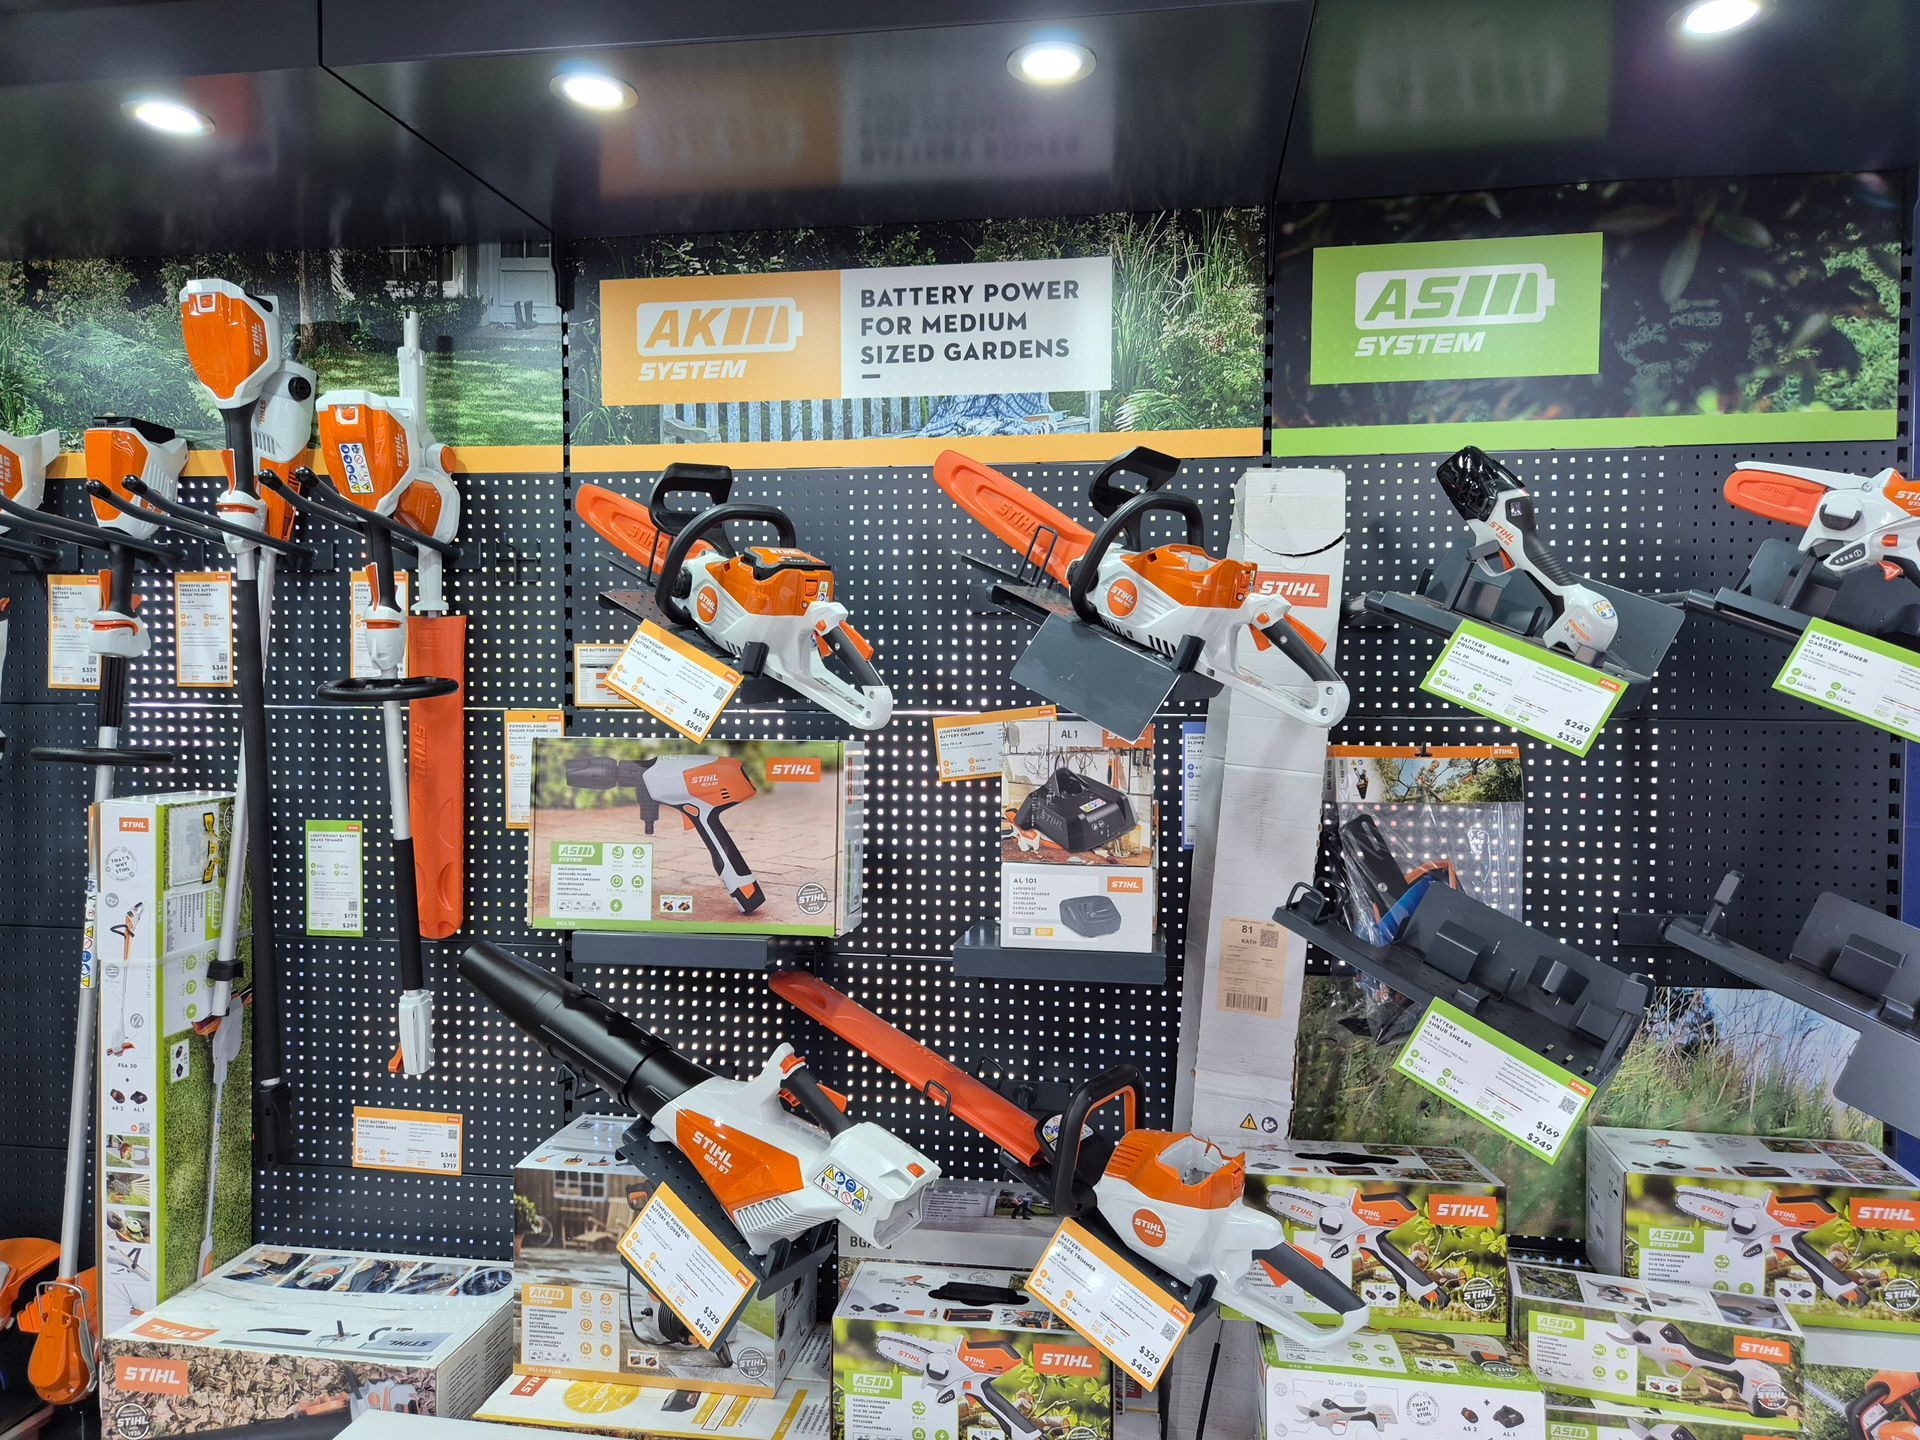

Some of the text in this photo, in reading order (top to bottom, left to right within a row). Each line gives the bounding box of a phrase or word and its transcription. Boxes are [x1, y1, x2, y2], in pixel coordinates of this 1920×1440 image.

[860, 280, 1079, 308] BATTERY POWER
[860, 311, 1027, 336] FOR MEDIUM
[251, 323, 260, 357] STIHL
[1355, 332, 1486, 357] SYSTEM
[861, 339, 1070, 364] SIZED GARDENS
[639, 359, 747, 381] SYSTEM
[394, 433, 404, 468] STIHL
[1489, 521, 1514, 544] STIHL
[1110, 586, 1134, 604] STIHL
[1259, 580, 1321, 598] STIHL
[699, 592, 715, 611] STIHL
[637, 633, 665, 651] LIGHTWEIGHT
[1460, 636, 1488, 650] BATTERY
[1811, 634, 1842, 648] BATTERY
[635, 639, 671, 662] BATTERY CHAINSAW
[1457, 641, 1510, 666] PRUNING SHEARS
[1808, 639, 1869, 664] GARDEN PRUNER
[693, 708, 710, 722] $399
[685, 719, 703, 733] $549
[1061, 729, 1078, 739] AL 1
[1564, 718, 1591, 734] $249
[1557, 731, 1583, 747] $329
[415, 723, 427, 782] STIHL
[771, 763, 815, 775] STIHL
[691, 774, 719, 785] STIHL
[1039, 811, 1064, 832] STIHL
[1112, 880, 1139, 889] STIHL
[799, 892, 827, 904] STIHL
[1242, 925, 1253, 934] 81
[1431, 1015, 1457, 1032] BATTERY
[1429, 1021, 1473, 1048] SHRUB SHEARS
[1536, 1121, 1560, 1138] $169
[692, 1130, 733, 1168] STIHL
[1527, 1133, 1553, 1151] $249
[704, 1153, 718, 1167] BGA
[1289, 1204, 1314, 1218] STIHL
[1357, 1208, 1381, 1218] STIHL
[1436, 1204, 1489, 1218] STIHL
[1699, 1204, 1726, 1218] STIHL
[1772, 1209, 1798, 1219] STIHL
[1857, 1207, 1916, 1222] STIHL
[651, 1205, 667, 1221] BATTERY
[665, 1220, 681, 1238] BLOWER
[654, 1200, 672, 1218] COMPACT
[670, 1215, 690, 1240] POWERFUL
[1135, 1218, 1164, 1234] STIHL
[1060, 1235, 1082, 1252] BATTERY
[1057, 1240, 1097, 1272] HEDGE TRIMMER
[1464, 1289, 1496, 1300] STIHL
[1885, 1290, 1919, 1300] STIHL
[704, 1306, 720, 1325] $329
[1173, 1308, 1188, 1320] STIHL
[151, 1324, 207, 1338] STIHL
[695, 1319, 712, 1337] $429
[898, 1350, 920, 1363] STIHL
[1139, 1345, 1160, 1365] $329
[1661, 1346, 1683, 1354] STIHL
[1740, 1341, 1784, 1357] STIHL
[737, 1357, 767, 1368] STIHL
[963, 1355, 986, 1365] STIHL
[1040, 1353, 1093, 1368] STIHL
[1131, 1358, 1152, 1378] $459
[124, 1367, 180, 1385] STIHL
[1482, 1364, 1519, 1373] STIHL
[1757, 1391, 1788, 1400] STIHL
[117, 1418, 149, 1428] STIHL
